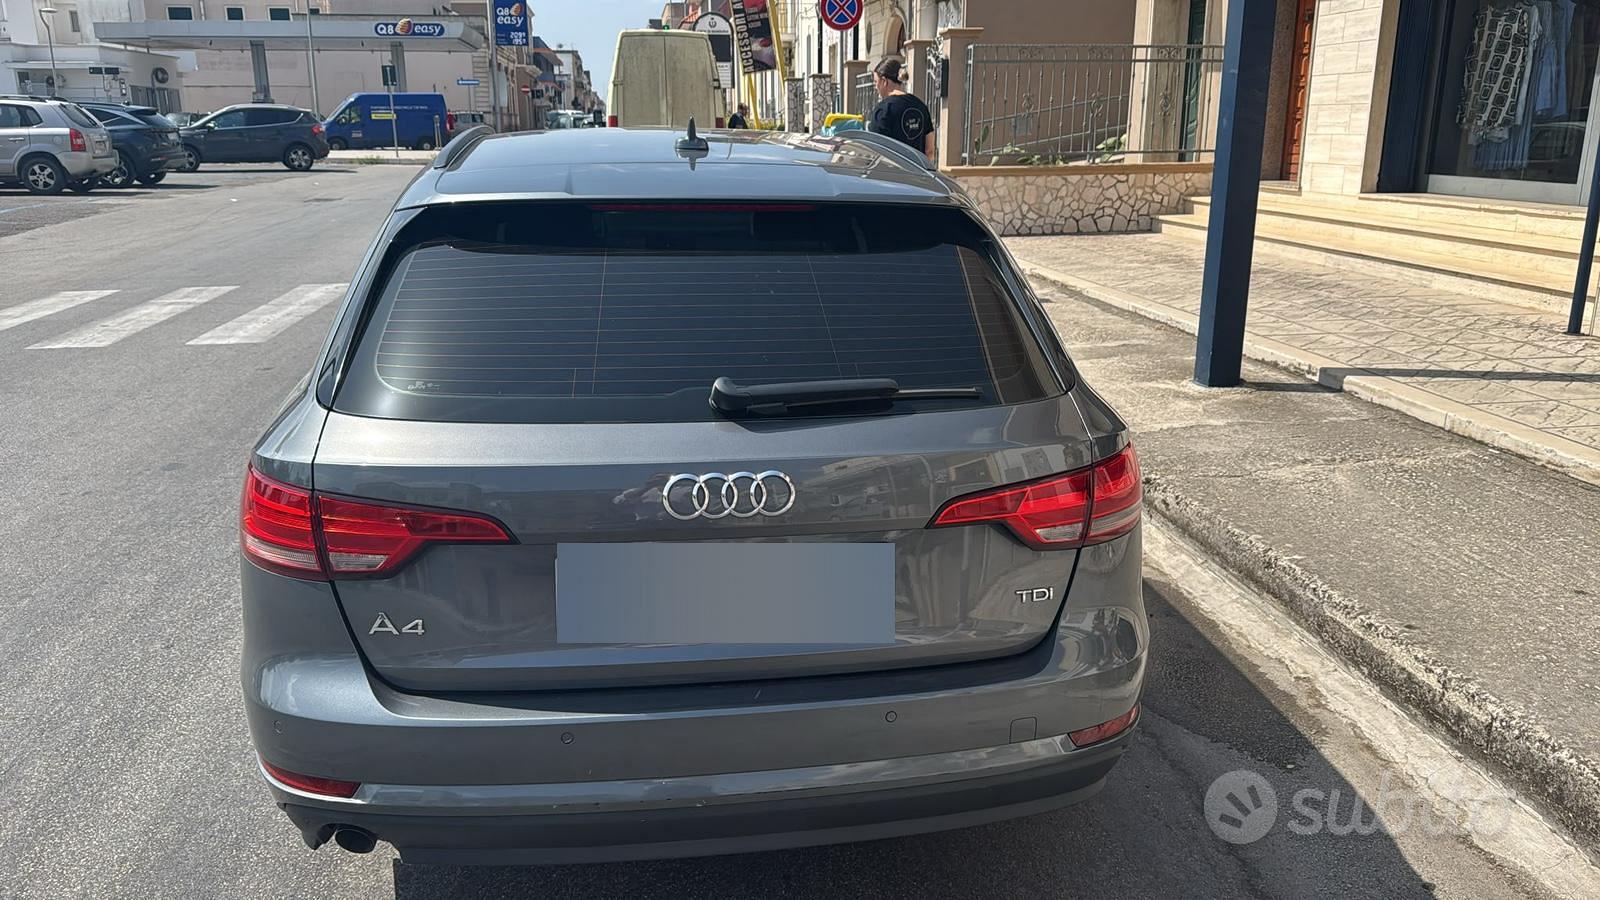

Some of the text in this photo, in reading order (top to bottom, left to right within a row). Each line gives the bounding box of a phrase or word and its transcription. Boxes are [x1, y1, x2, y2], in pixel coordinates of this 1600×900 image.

[496, 7, 510, 16] Q8
[497, 16, 524, 27] easy
[377, 24, 441, 36] Q8 easy
[735, 13, 755, 72] ACCESSORI
[1015, 587, 1054, 603] TDI
[368, 612, 425, 636] A4
